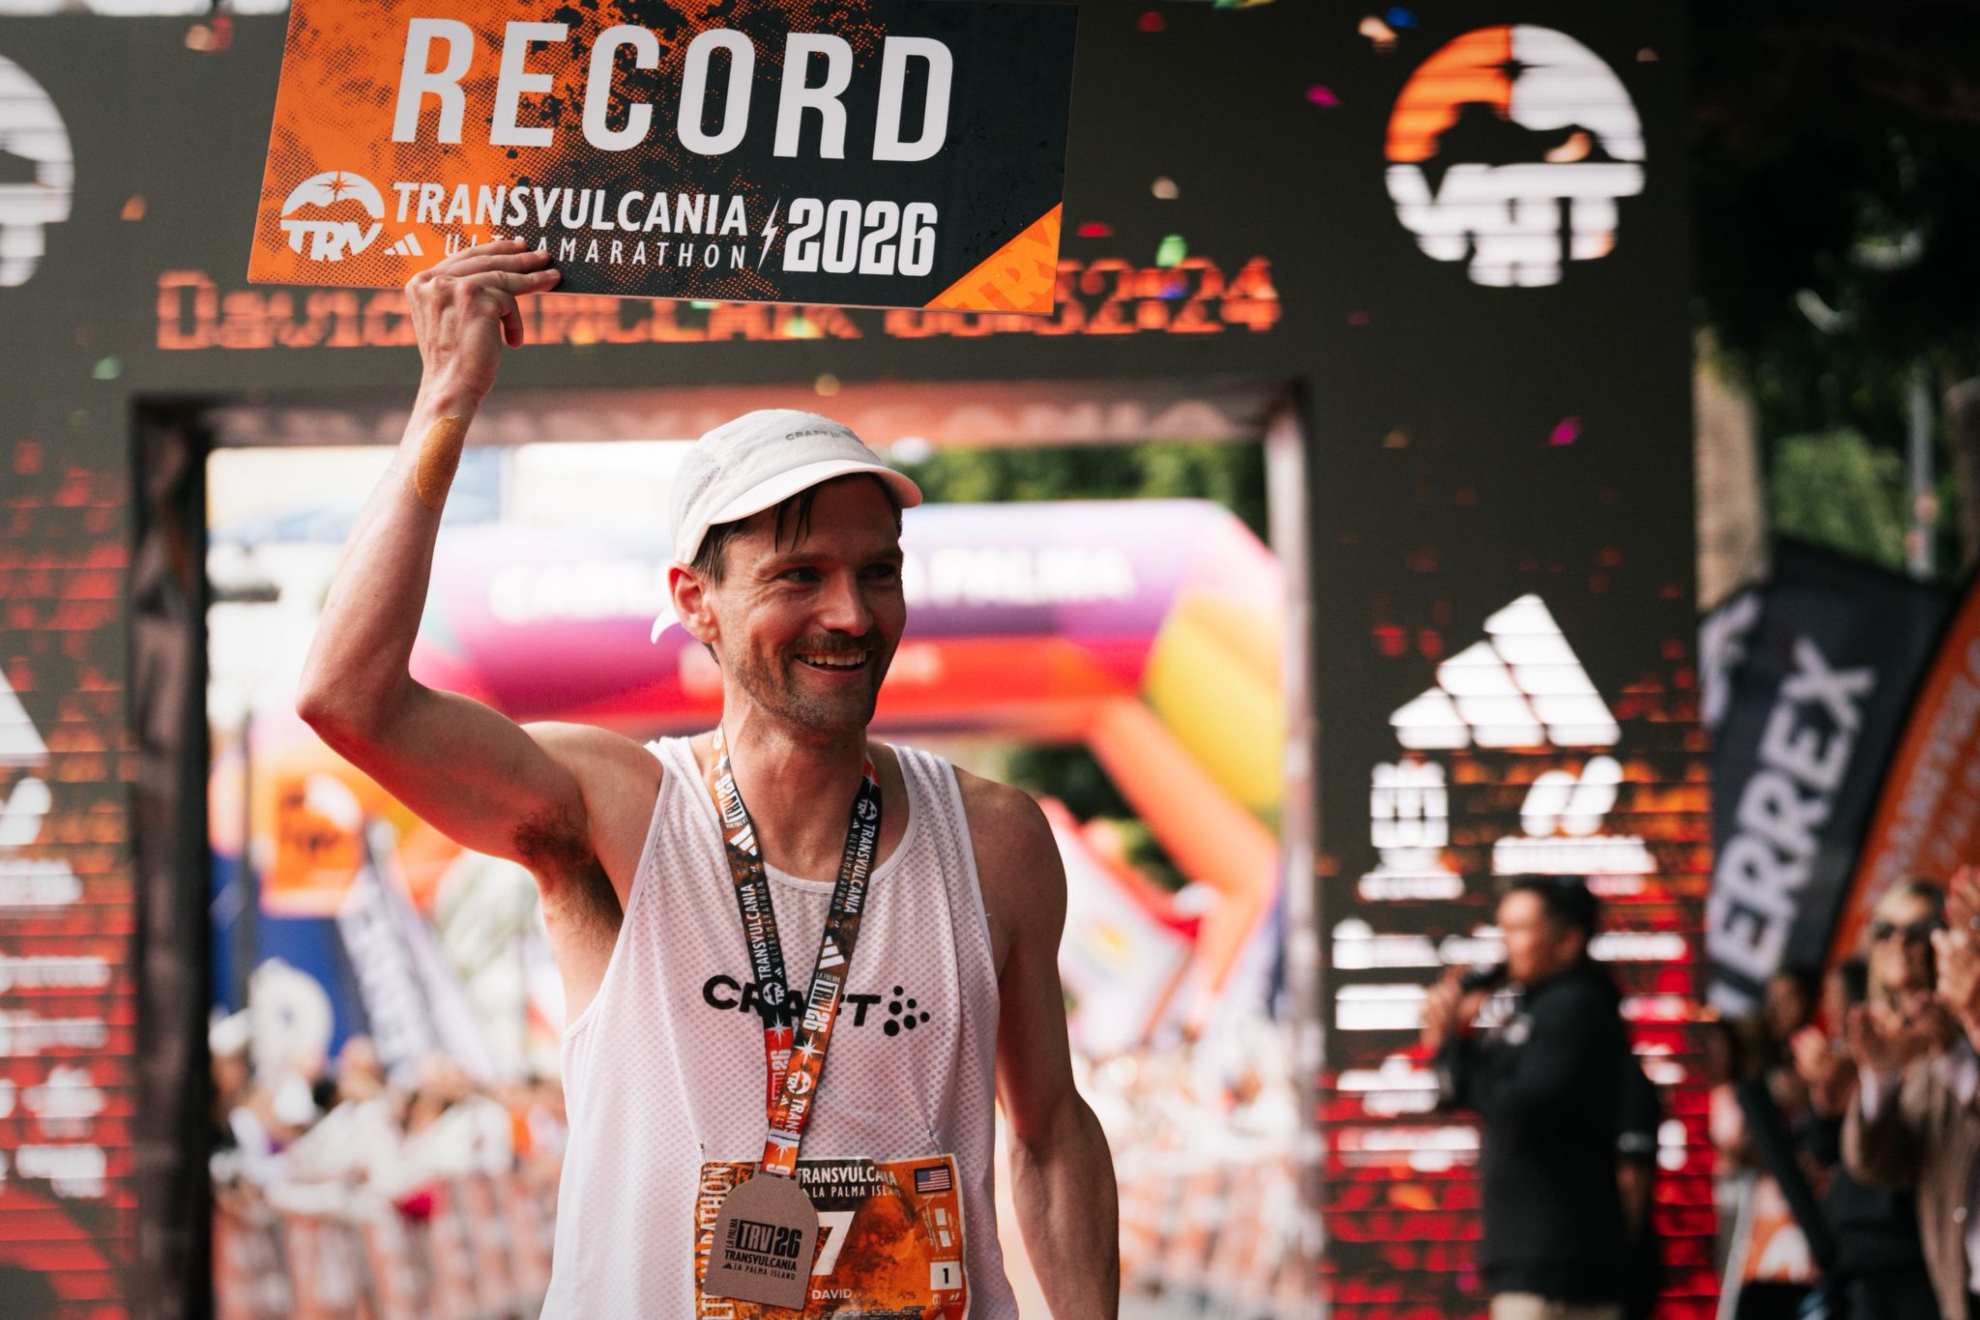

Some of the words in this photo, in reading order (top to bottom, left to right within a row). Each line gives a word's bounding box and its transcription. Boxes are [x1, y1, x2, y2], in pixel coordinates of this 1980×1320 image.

[391, 17, 955, 164] RECORD
[393, 181, 749, 237] TRANSVULCANIA
[280, 219, 384, 262] TRV
[444, 233, 747, 270] ULAMARATHON
[782, 197, 938, 277] 2026
[843, 824, 876, 914] TRANSVULCANIA
[740, 884, 772, 981] TRANSVULCANIA
[757, 881, 780, 963] ULTRAMARATHON
[812, 1187, 825, 1198] LA
[830, 1185, 865, 1198] PALMA
[727, 1218, 739, 1239] PALMA
[725, 1249, 797, 1272] TRANSVULCANIA
[733, 1263, 742, 1271] LA
[745, 1265, 767, 1276] PALMA
[770, 1269, 796, 1280] ISLAND
[943, 1267, 949, 1285] 1
[811, 1288, 853, 1300] DAVID
